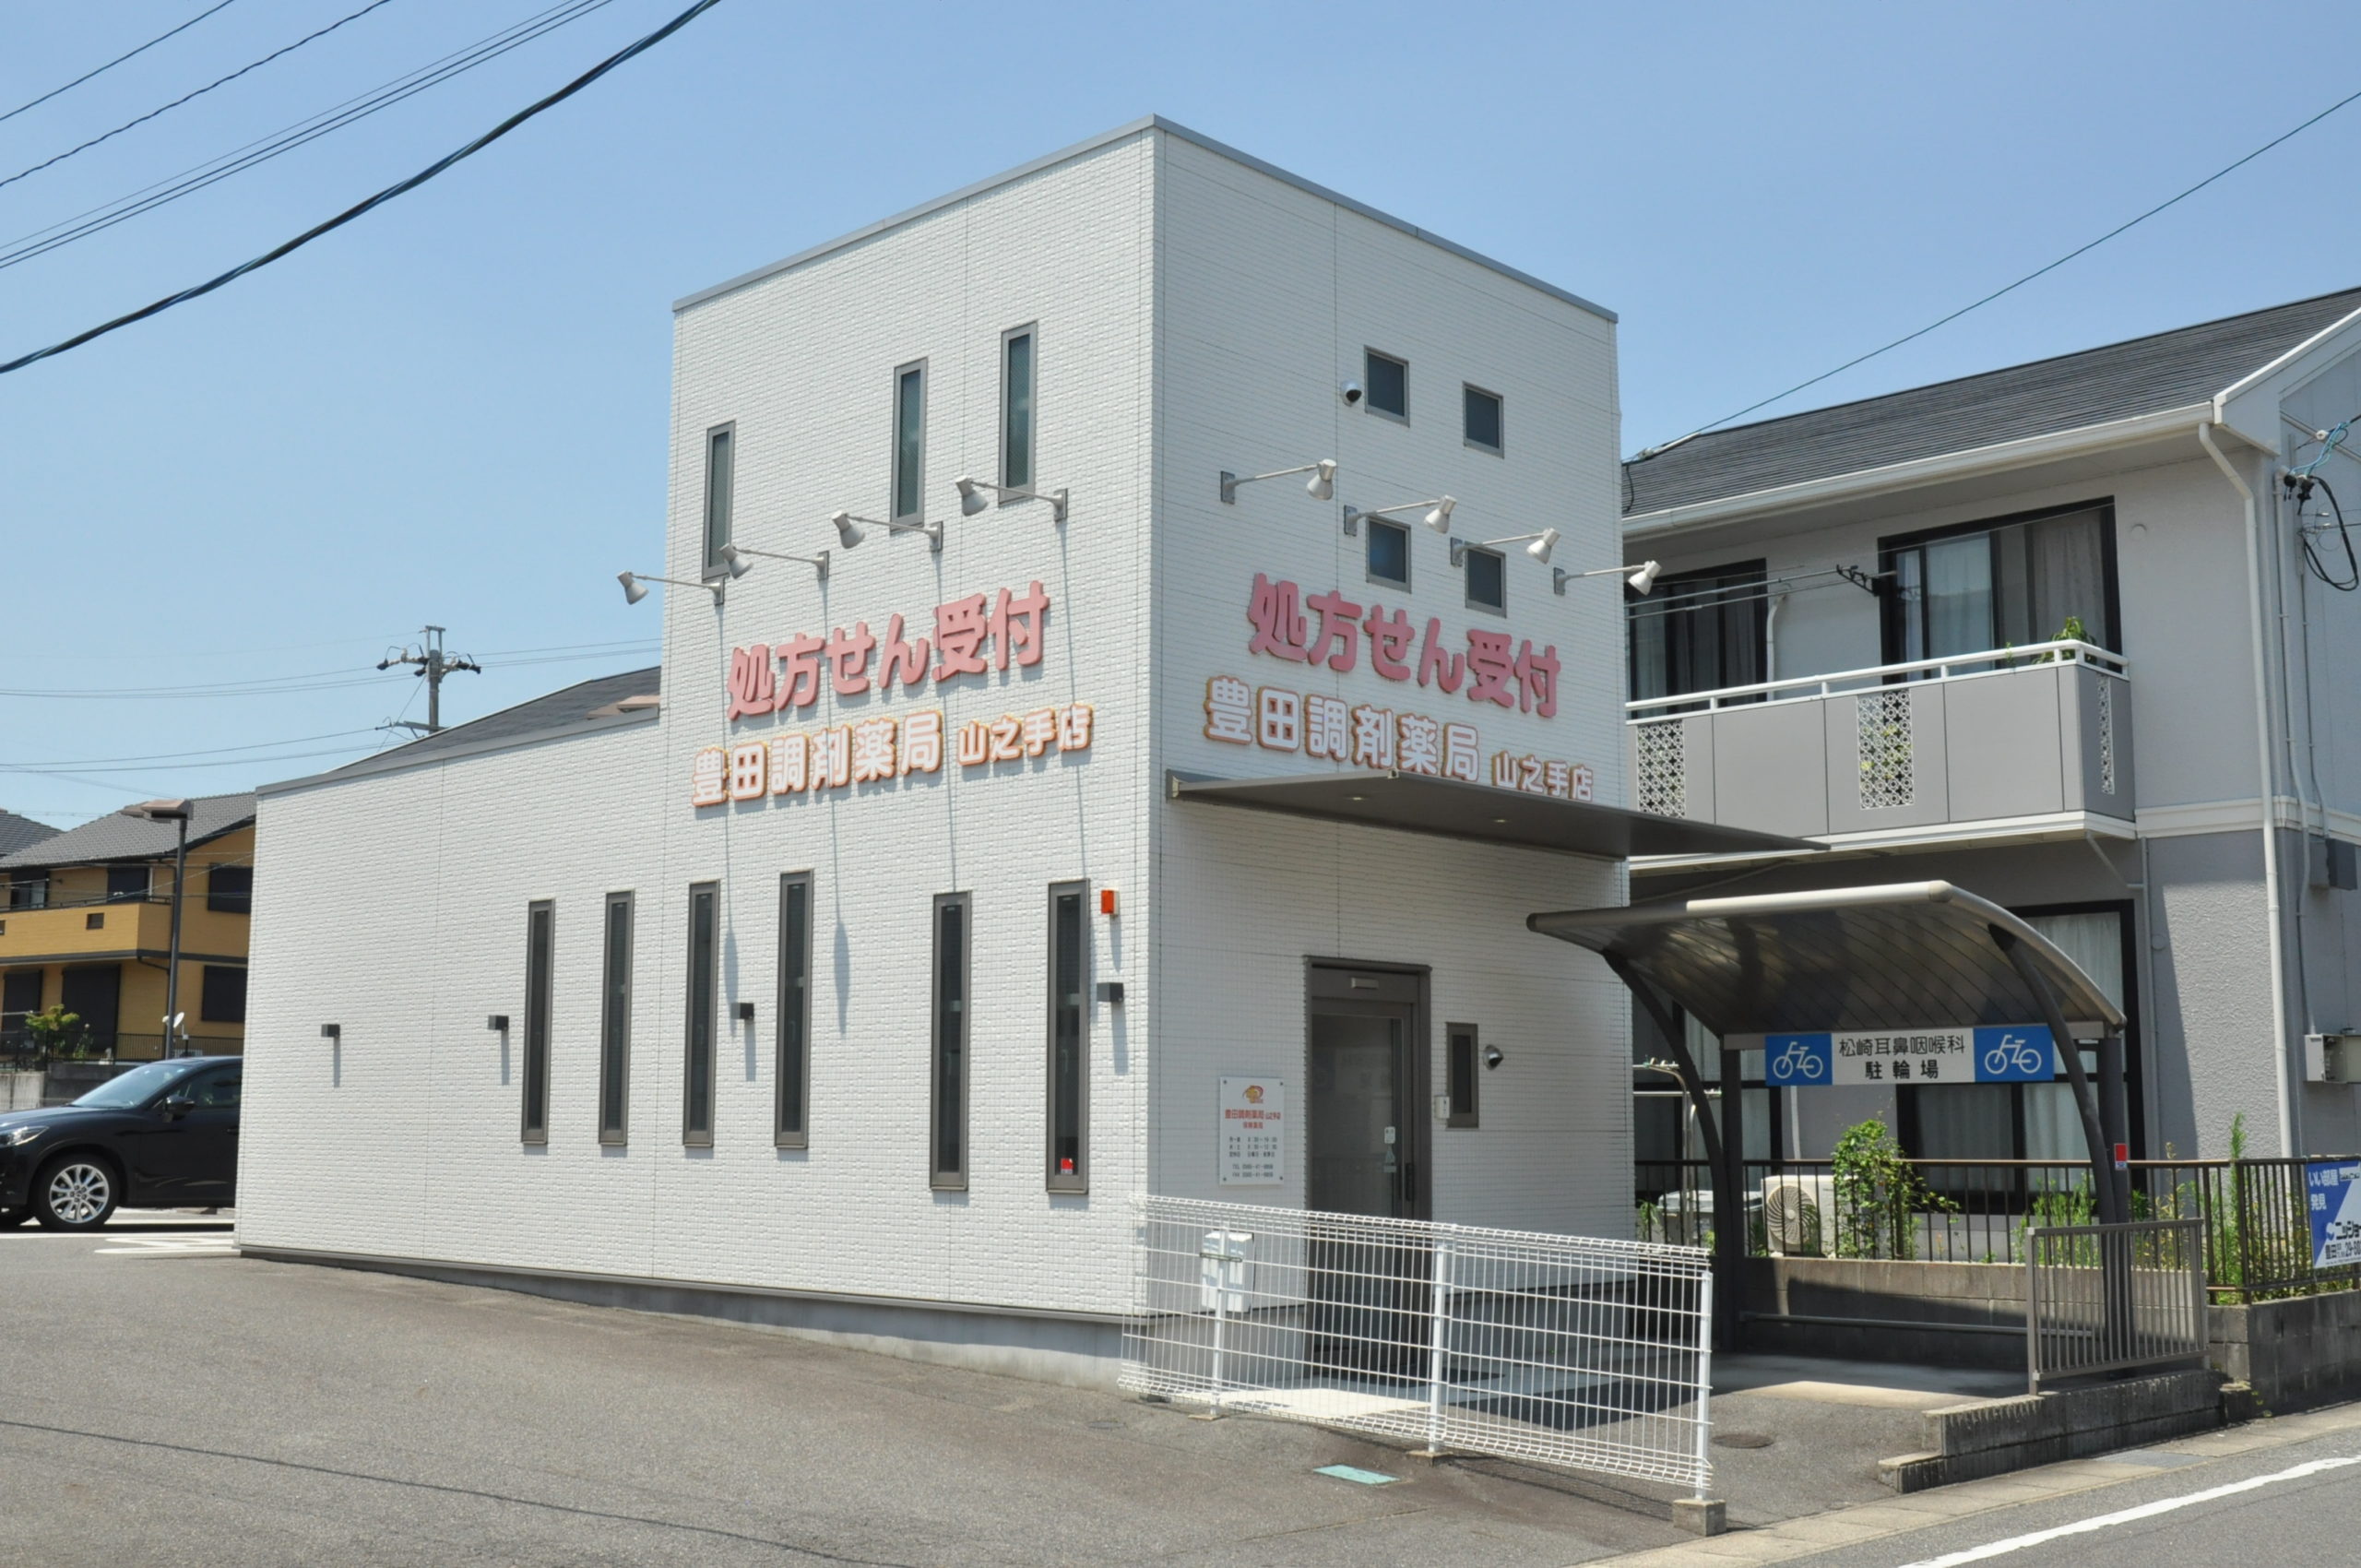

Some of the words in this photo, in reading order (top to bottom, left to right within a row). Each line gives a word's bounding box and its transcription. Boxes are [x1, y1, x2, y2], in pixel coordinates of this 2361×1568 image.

[727, 580, 1050, 721] 処方せん受付
[1247, 572, 1561, 719] 処方せん受付
[692, 709, 944, 807] 豊田調剤薬局
[956, 704, 1094, 766] 山之手店
[1204, 674, 1478, 782] 豊田調剤薬局
[1491, 750, 1594, 802] 山之手店
[1839, 1034, 1965, 1057] 松崎耳鼻咽喉科
[1865, 1060, 1940, 1080] 駐輪場
